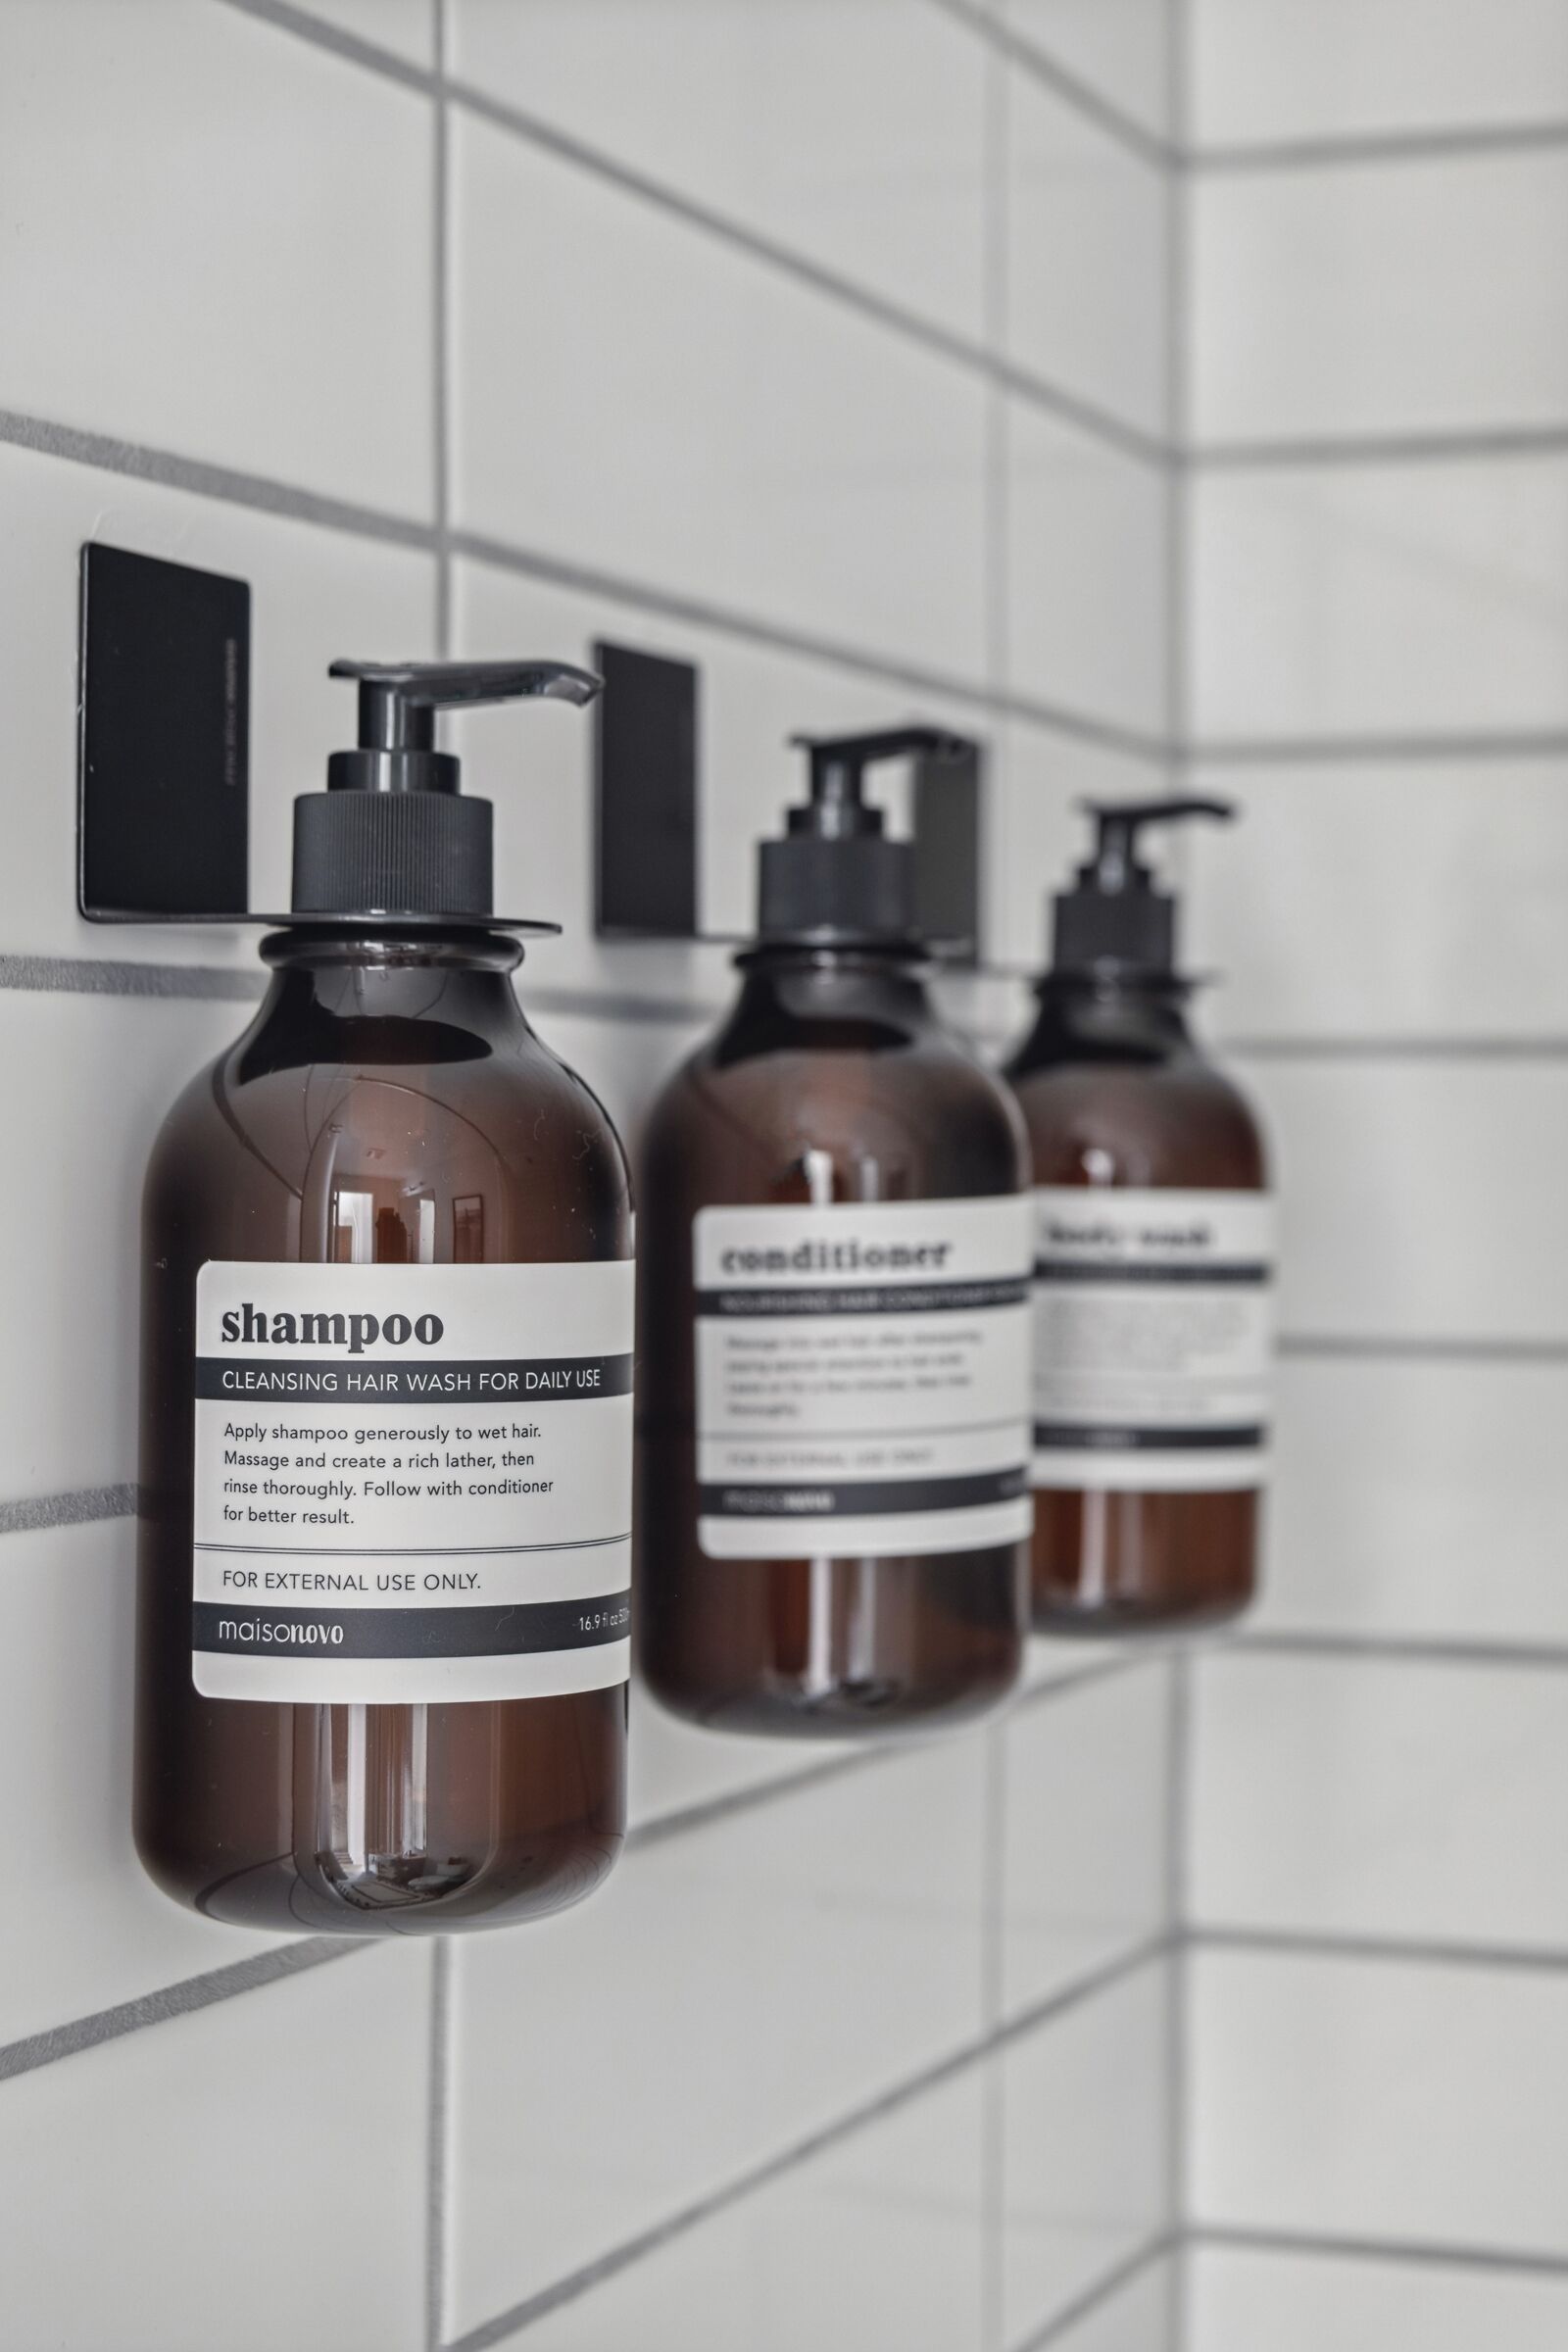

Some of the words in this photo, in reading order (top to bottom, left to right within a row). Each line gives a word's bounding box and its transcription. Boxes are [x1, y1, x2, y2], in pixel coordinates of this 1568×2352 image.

[722, 1240, 951, 1273] conditioner
[220, 1303, 444, 1353] shampoo
[222, 1371, 338, 1392] CLEANSING
[347, 1373, 399, 1392] HAIR
[407, 1373, 470, 1392] WASH
[479, 1372, 518, 1391] FOR
[525, 1370, 572, 1390] DAILY
[576, 1368, 601, 1388] USE
[223, 1422, 267, 1442] Apply
[271, 1423, 348, 1444] shampoo
[355, 1424, 450, 1445] generously
[456, 1426, 472, 1441] to
[478, 1425, 507, 1439] wet
[512, 1422, 541, 1438] hair.
[223, 1449, 289, 1470] Massage
[295, 1452, 325, 1468] and
[332, 1454, 386, 1468] create
[392, 1456, 402, 1468] a
[409, 1452, 439, 1468] rich
[446, 1452, 496, 1469] lather,
[502, 1450, 534, 1466] then
[223, 1478, 258, 1494] rinse
[263, 1479, 357, 1500] thoroughly.
[364, 1481, 421, 1496] Follow
[427, 1480, 463, 1495] with
[468, 1478, 554, 1495] conditioner
[223, 1504, 243, 1521] for
[248, 1505, 297, 1523] better
[303, 1508, 355, 1524] result.
[222, 1570, 258, 1589] FOR
[265, 1572, 368, 1592] EXTERNAL
[376, 1574, 416, 1592] USE
[423, 1572, 481, 1592] ONLY.
[219, 1618, 344, 1644] maisonovo
[579, 1614, 601, 1632] 16.9
